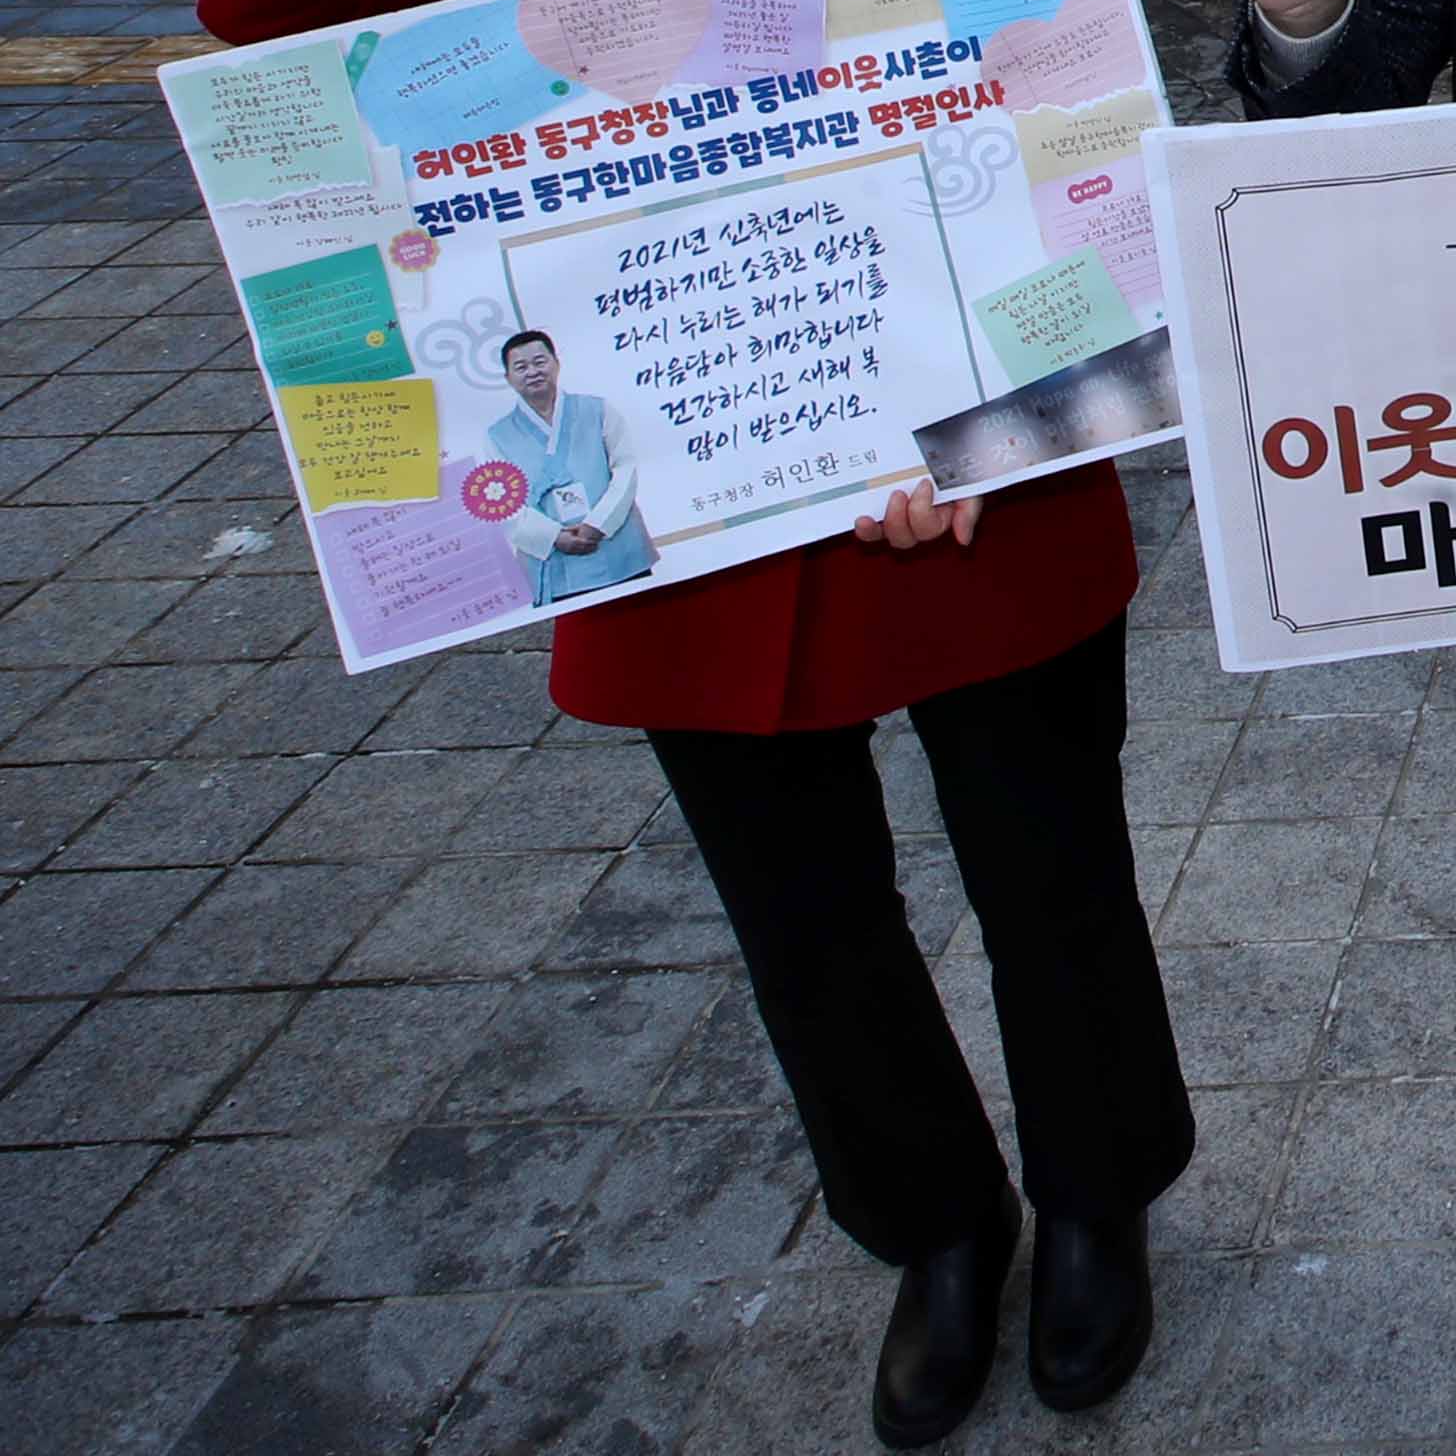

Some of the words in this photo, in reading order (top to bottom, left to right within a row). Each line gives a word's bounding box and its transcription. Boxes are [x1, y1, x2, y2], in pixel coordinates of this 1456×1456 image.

[412, 131, 528, 181] 허인환
[534, 88, 740, 163] 동구청장님과
[750, 35, 985, 116] 동네이웃사촌이
[413, 185, 524, 240] 전하는
[531, 109, 860, 215] 동구한마음종합복지관
[868, 78, 1007, 140] 명절인사
[593, 259, 737, 317] 평범하지만
[740, 251, 809, 287] 소중한
[813, 225, 887, 262] 일상을
[617, 227, 711, 273] 2021년
[718, 199, 847, 245] 신축년에는
[612, 315, 671, 352] 다시
[678, 306, 748, 347] 누리는
[751, 292, 809, 320] 해가
[816, 263, 889, 302] 되기를
[634, 346, 739, 389] 마음담아
[746, 312, 886, 363] 희망합니다
[658, 378, 792, 426] 건강하시고
[798, 357, 852, 387] 새해
[862, 346, 882, 377] 복
[686, 430, 740, 464] 많이
[749, 394, 879, 443] 받으십시오.
[689, 483, 756, 513] 동구청장
[759, 453, 842, 490] 허인환
[847, 449, 880, 470] 드림
